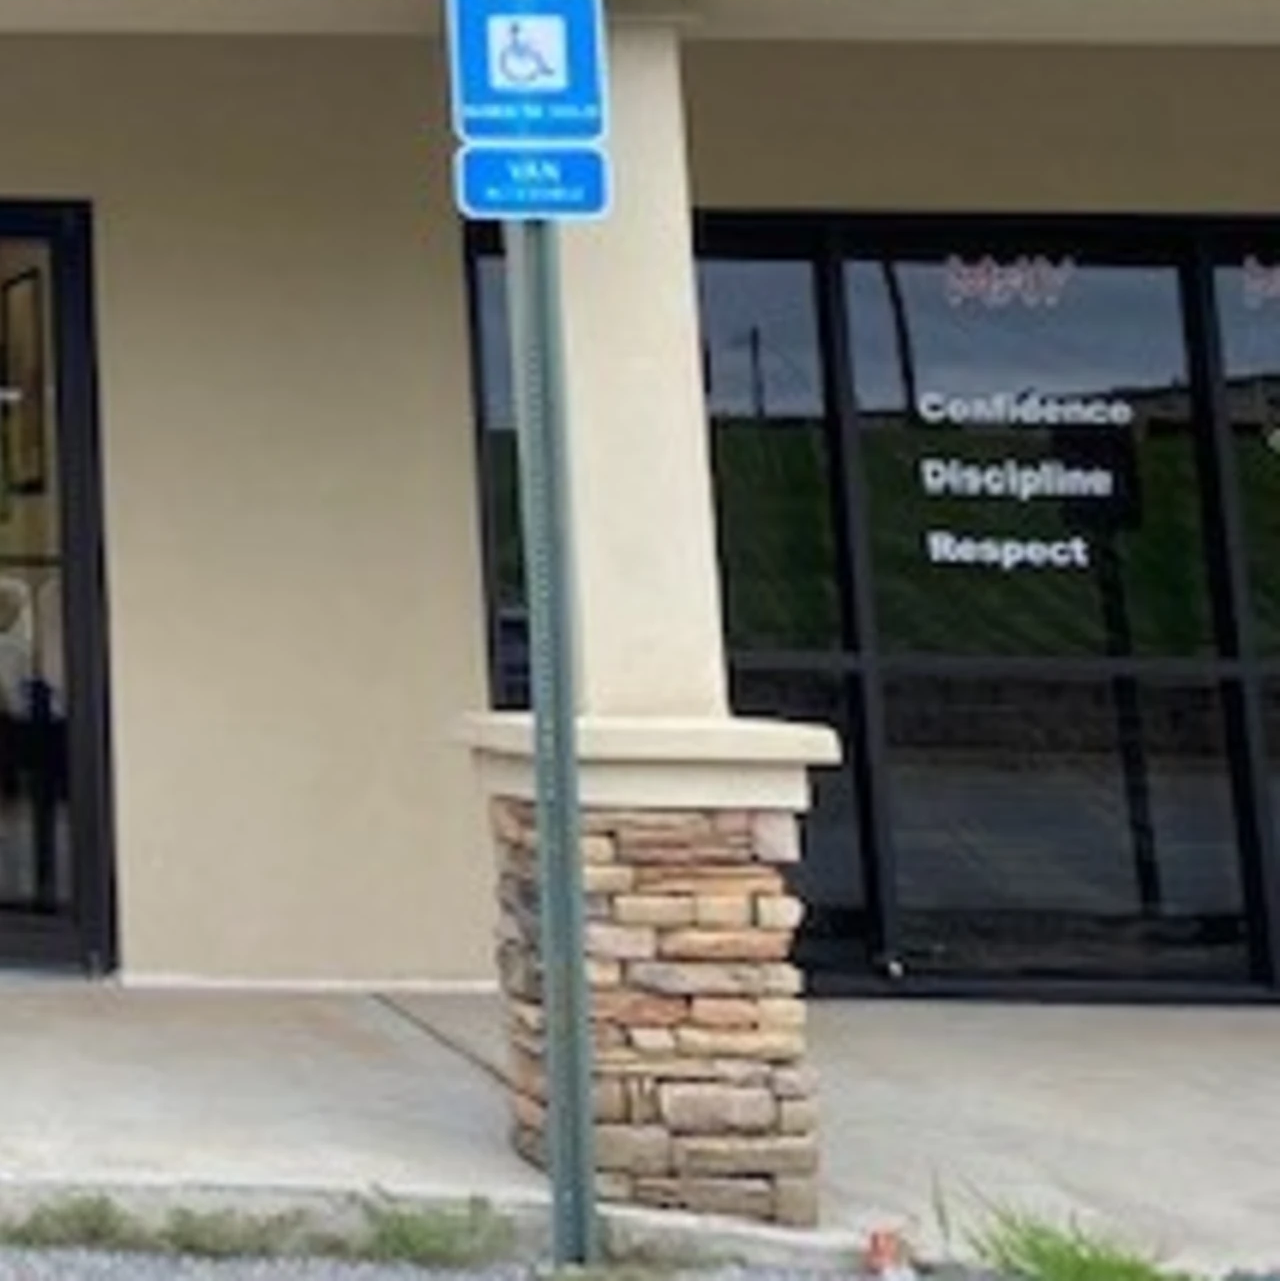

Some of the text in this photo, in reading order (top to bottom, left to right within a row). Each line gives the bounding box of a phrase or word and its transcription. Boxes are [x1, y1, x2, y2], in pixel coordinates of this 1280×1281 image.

[504, 161, 561, 184] VAN
[919, 392, 1132, 425] Confidence
[920, 458, 1113, 501] Discipline
[926, 533, 1091, 569] Respect
